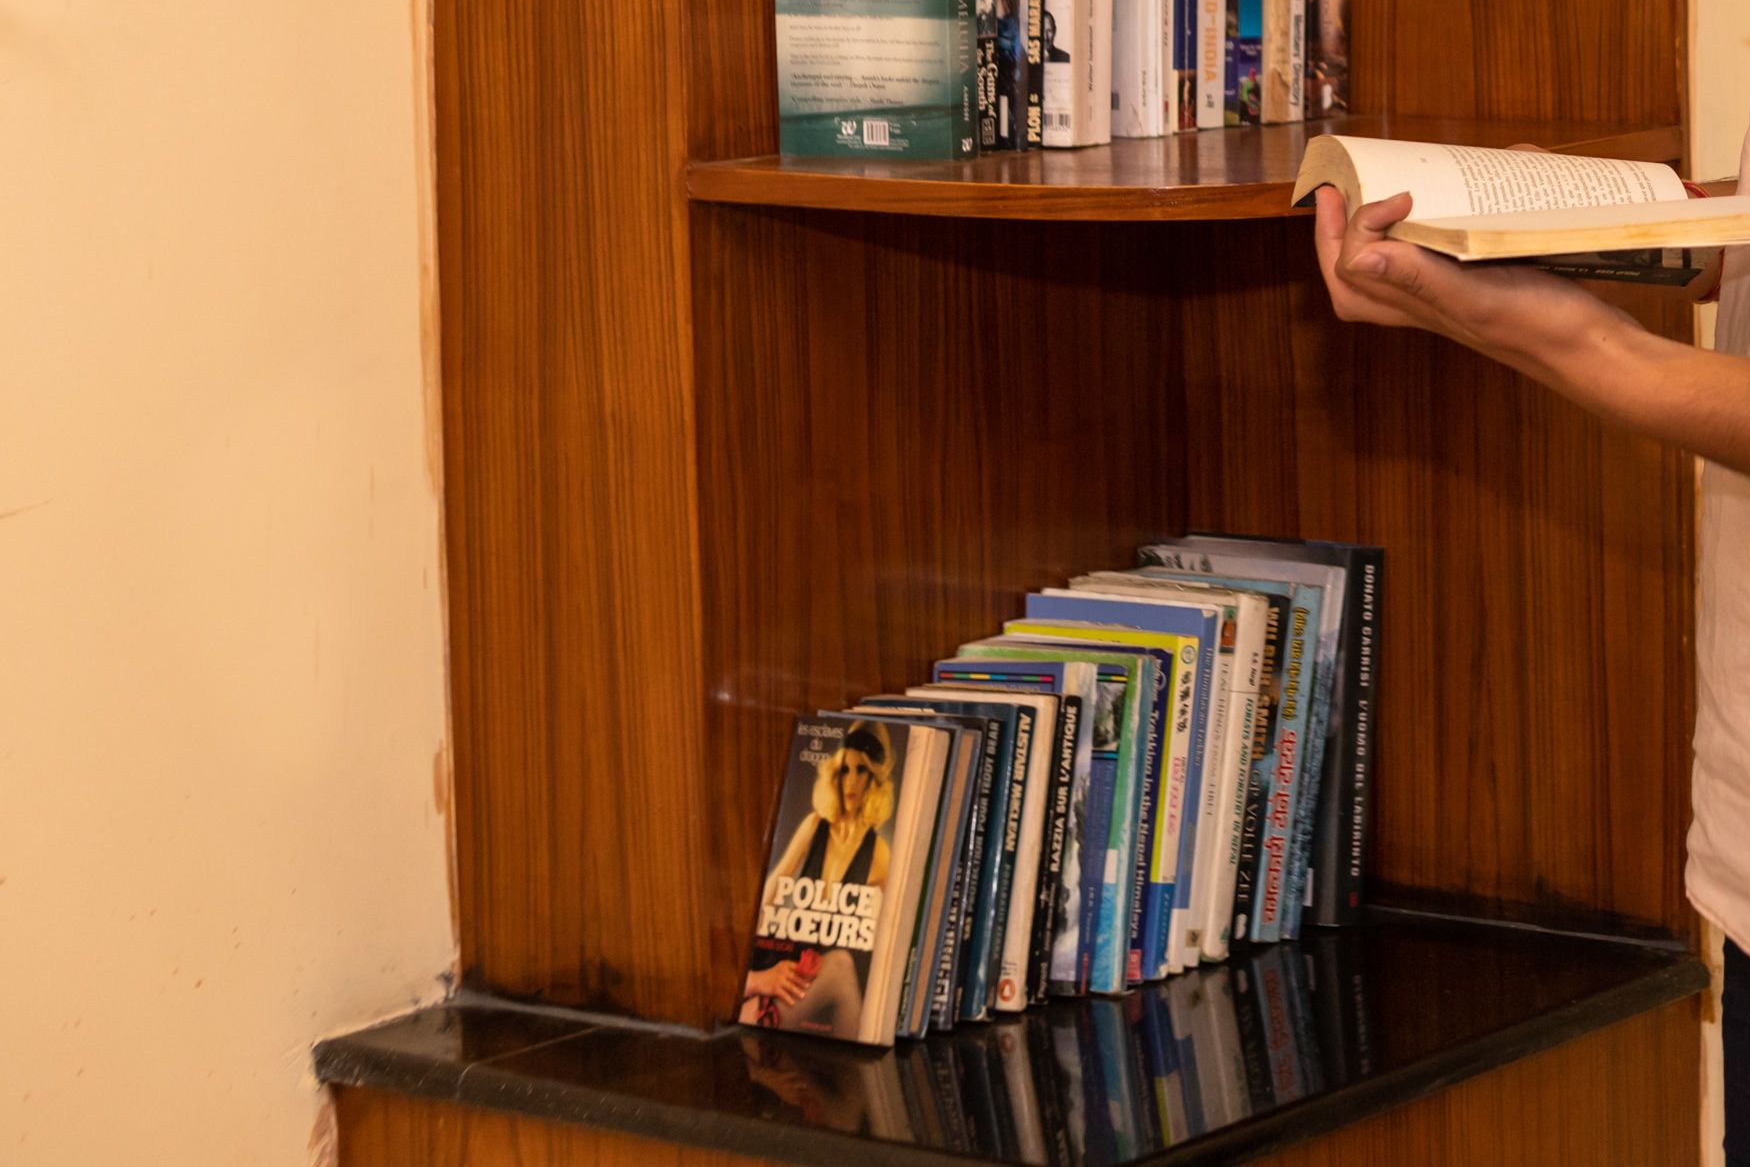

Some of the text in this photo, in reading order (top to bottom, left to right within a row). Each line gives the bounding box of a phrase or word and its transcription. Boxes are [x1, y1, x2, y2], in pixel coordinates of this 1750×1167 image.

[985, 39, 995, 61] The
[1027, 38, 1041, 65] SAS
[977, 66, 989, 111] South
[1026, 106, 1041, 142] PLON
[1202, 647, 1213, 664] The
[1251, 606, 1279, 760] WILBUR SMITH
[1059, 705, 1077, 782] L'ANTIQUE
[1143, 710, 1159, 774] Trekking
[1350, 564, 1374, 877] DONATO CARRISI L'UOMO DEL LABIRINTO
[810, 738, 823, 750] du
[1011, 712, 1031, 780] ALISTAIR
[1055, 785, 1069, 814] SUR
[1140, 795, 1151, 812] the
[1142, 778, 1153, 788] in
[1227, 698, 1254, 865] FORESTS AND FORESTRY IN NEPAL
[964, 721, 999, 912] PROTECTION POUR TEDDY BEAR
[1237, 769, 1261, 901] OP VOLLE ZEE
[1050, 817, 1065, 872] RAZZIA
[1135, 822, 1149, 866] Nepal
[773, 875, 879, 920] POLICE
[1129, 870, 1145, 938] Himalaya
[757, 905, 877, 952] MŒURS
